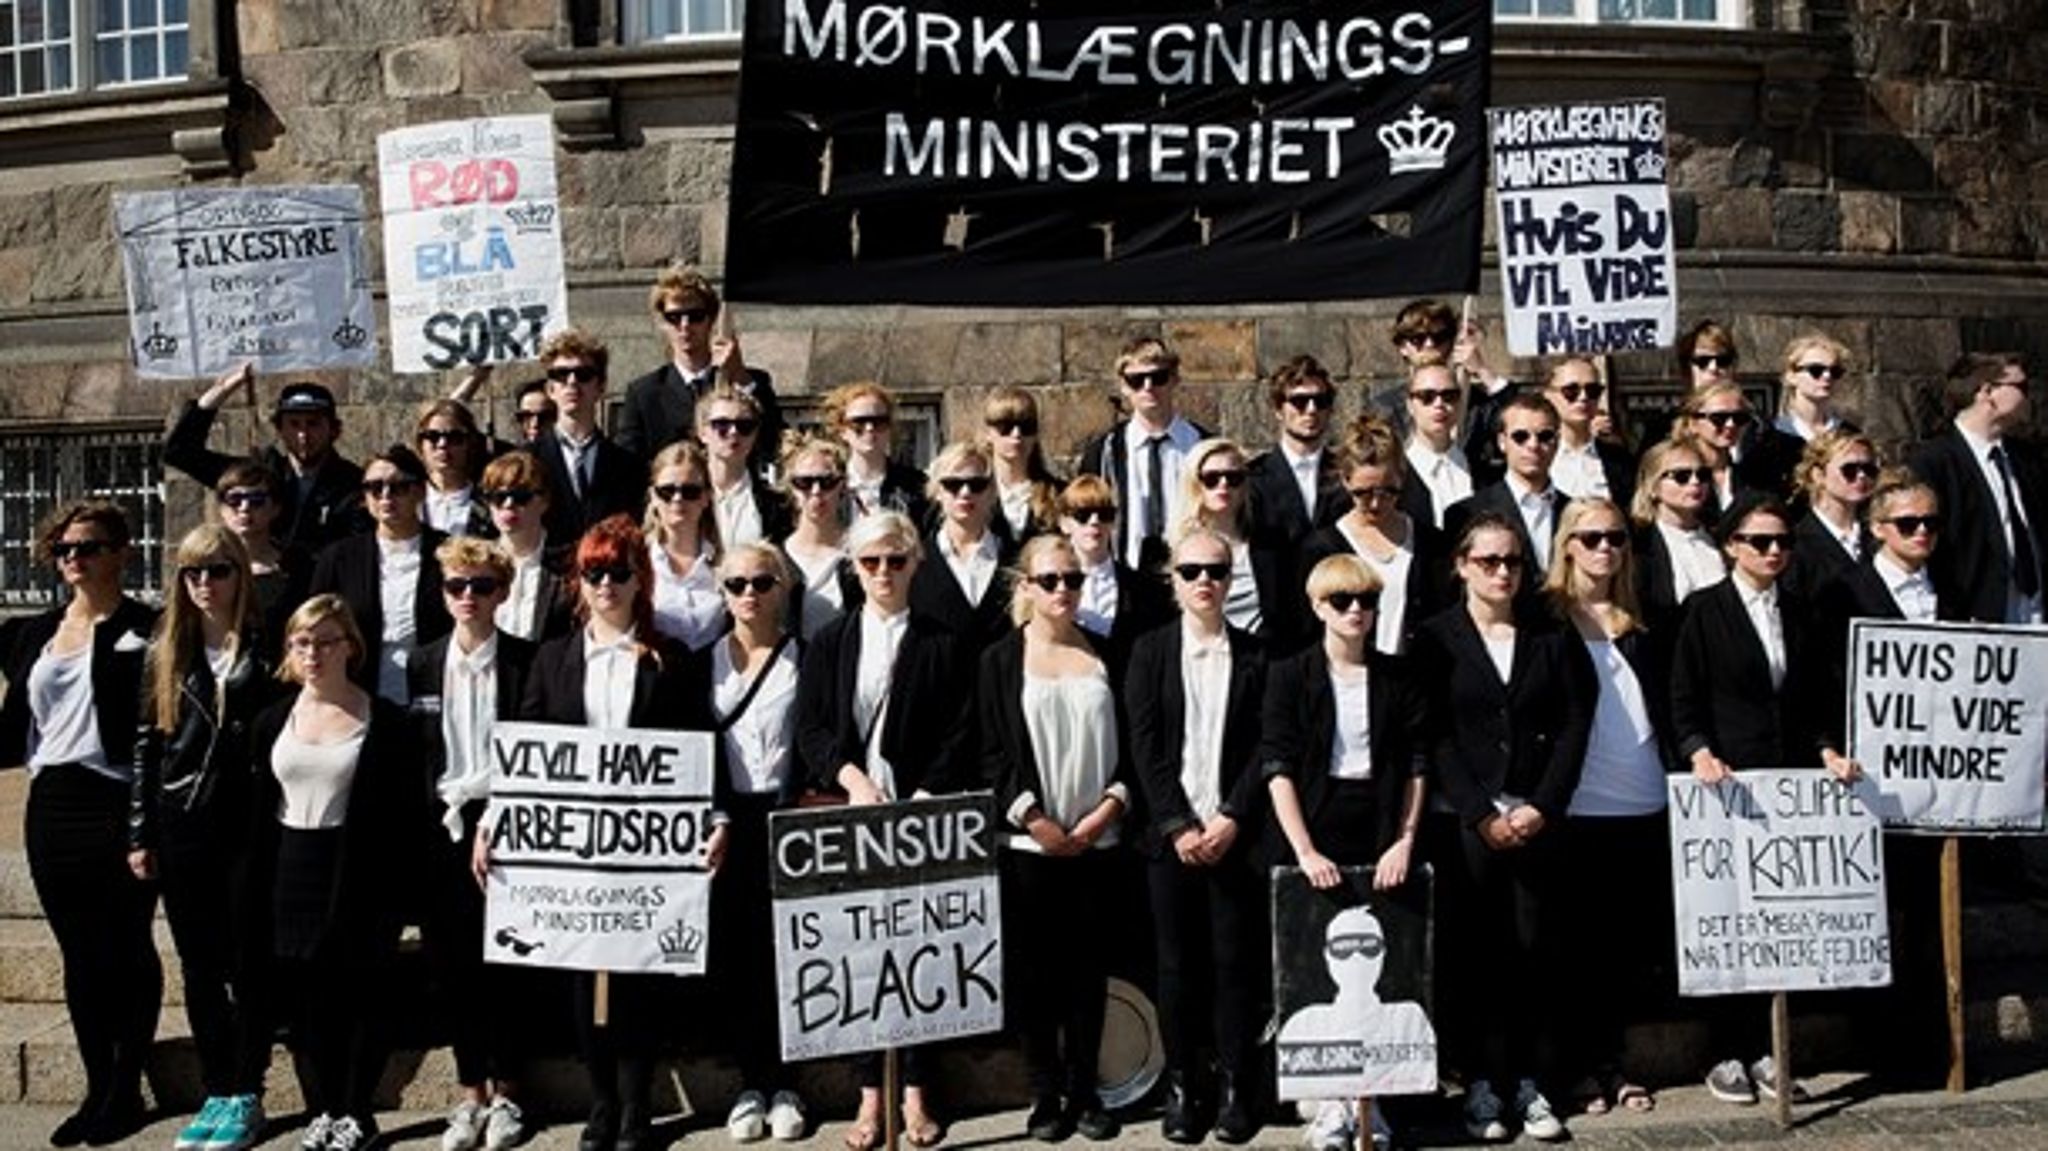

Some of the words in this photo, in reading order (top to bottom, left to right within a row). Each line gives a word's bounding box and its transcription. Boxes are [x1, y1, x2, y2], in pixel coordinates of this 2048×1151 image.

[783, 0, 1470, 85] MØRKLÆGNINGS-
[884, 112, 1355, 183] MINISTERIET
[409, 158, 519, 211] RØD
[415, 226, 515, 281] BLÅ
[422, 305, 548, 370] SORT
[1866, 640, 1955, 682] HVIS
[1974, 644, 2018, 684] DU
[1866, 691, 1926, 731] VIL
[1952, 696, 2025, 735] VIDE
[598, 744, 679, 785] HAVE
[1883, 744, 2007, 782] MINDRE
[1673, 785, 1706, 819] VI
[1716, 782, 1767, 819] VIL
[1775, 778, 1865, 818] SLIPPE
[491, 804, 711, 859] ARBEJDSRO!
[777, 810, 988, 877] CENSUR
[1682, 838, 1735, 880] FOR
[1748, 825, 1880, 891] KRITIK!
[533, 910, 659, 933] MINISTERIET
[791, 912, 822, 950] IS
[843, 899, 914, 940] THE
[923, 889, 985, 934] NEW
[1697, 914, 1730, 937] DET
[1735, 913, 1759, 936] ER
[1818, 911, 1876, 933] PINLIGT
[1723, 942, 1735, 969] I
[1823, 936, 1890, 967] FEJLENE
[792, 939, 998, 1033] BLACK
